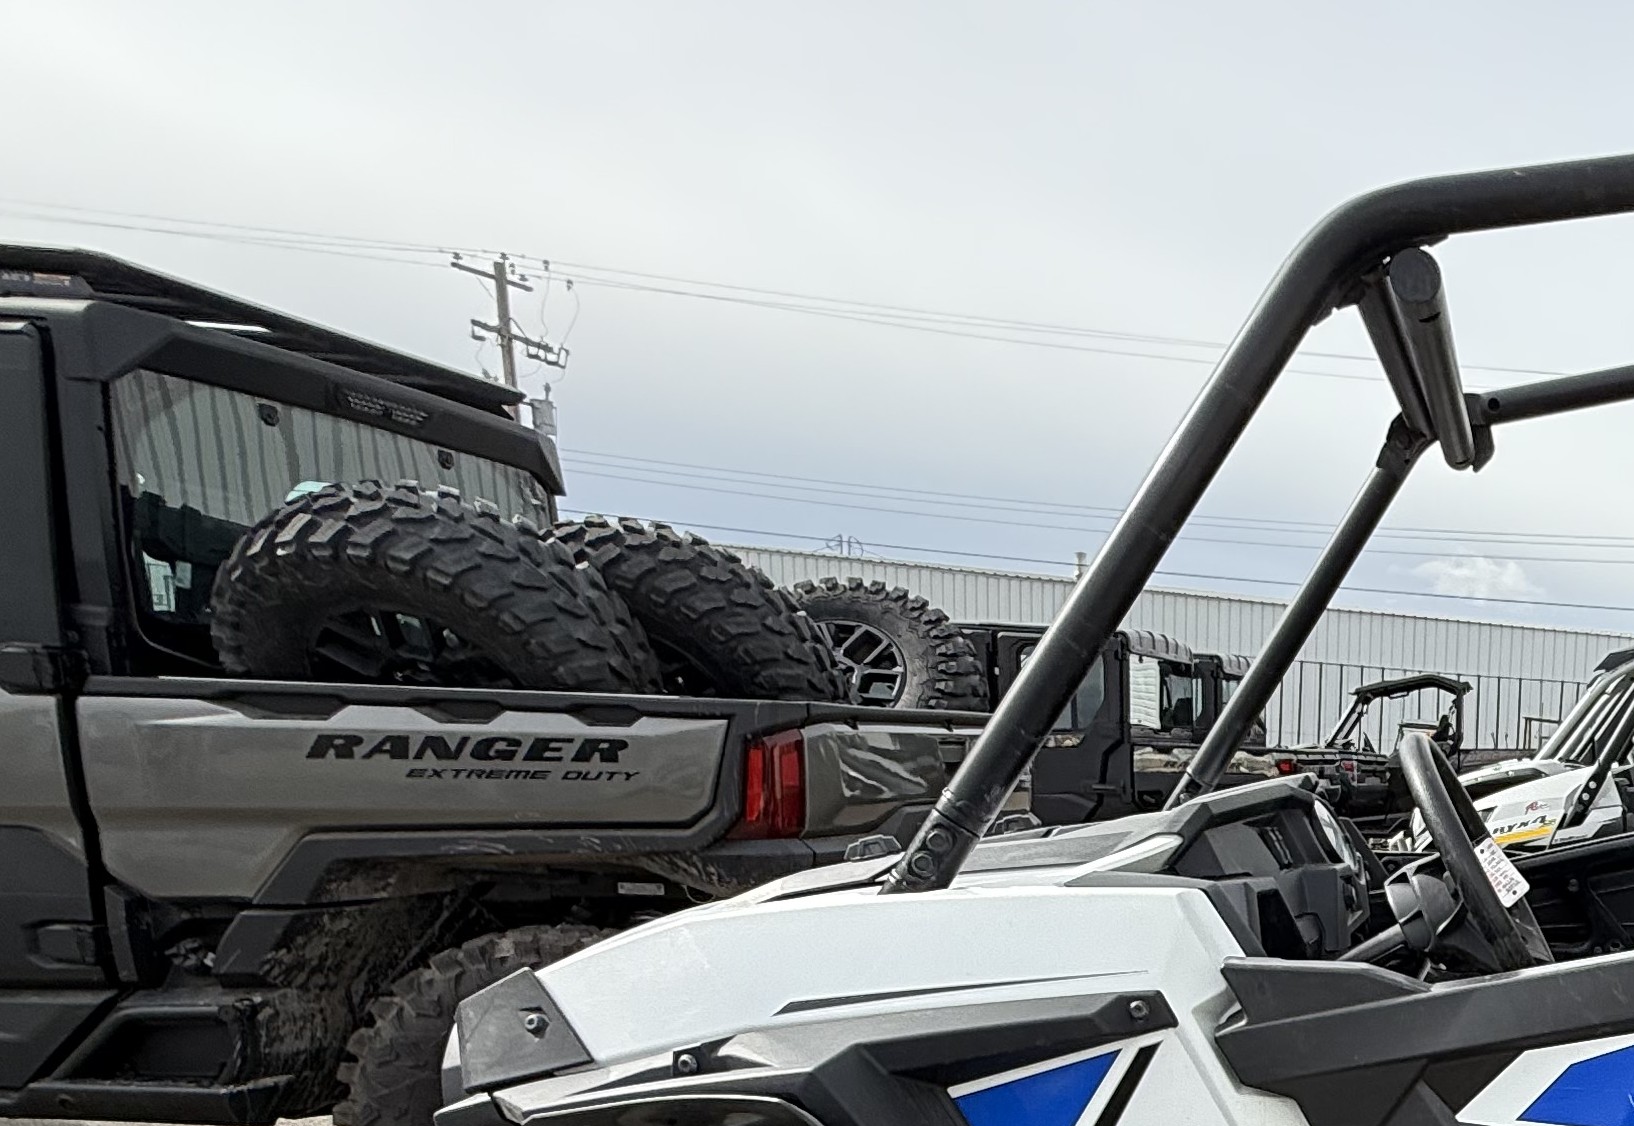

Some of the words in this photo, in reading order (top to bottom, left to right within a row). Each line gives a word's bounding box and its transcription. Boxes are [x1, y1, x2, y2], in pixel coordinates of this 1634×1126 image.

[306, 734, 629, 763] RANGER
[406, 768, 552, 781] EXTREME
[562, 770, 640, 782] DUTY
